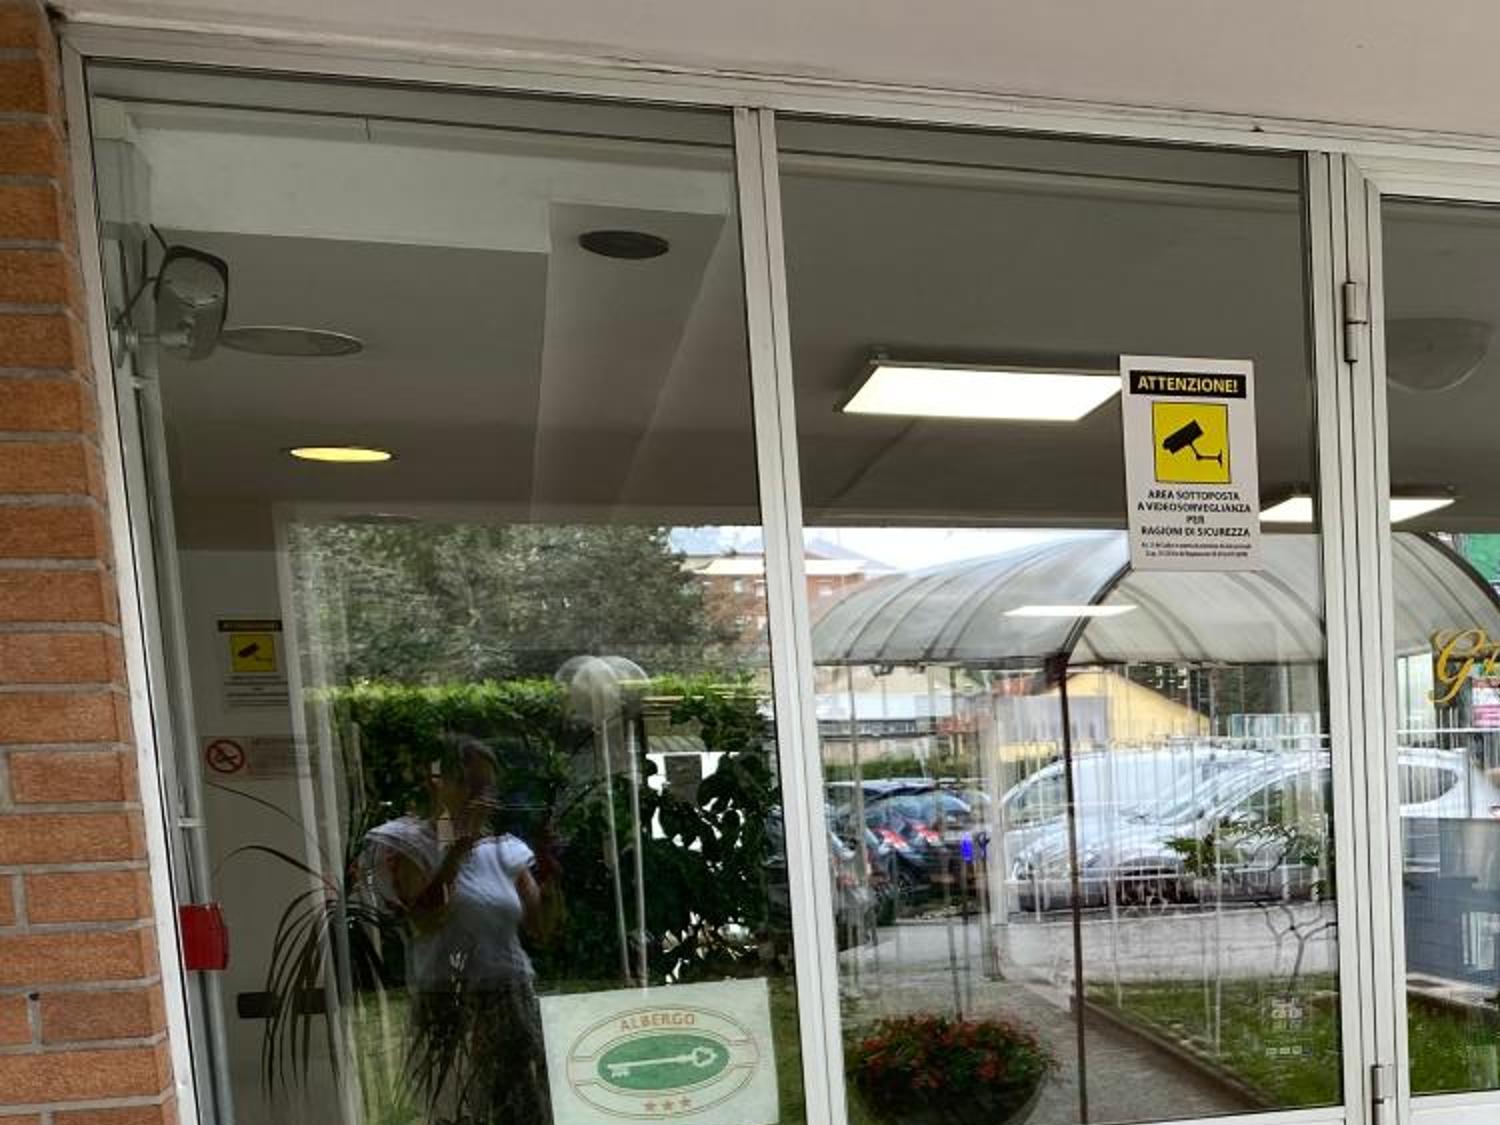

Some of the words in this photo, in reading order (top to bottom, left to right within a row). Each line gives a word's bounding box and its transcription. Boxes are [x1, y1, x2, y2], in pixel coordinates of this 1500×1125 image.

[1138, 375, 1239, 393] ATTENZIONE!
[1148, 489, 1174, 499] AREA
[1176, 491, 1241, 500] SOTTOPOSTA
[1137, 502, 1145, 511] A
[1147, 502, 1251, 513] VIDEOSORVEGLIANZA
[1185, 515, 1205, 524] PER
[1141, 526, 1183, 536] RAGIONI
[1185, 527, 1196, 536] DI
[1197, 527, 1251, 537] SICUREZZA
[619, 1013, 696, 1032] ALBERGO
